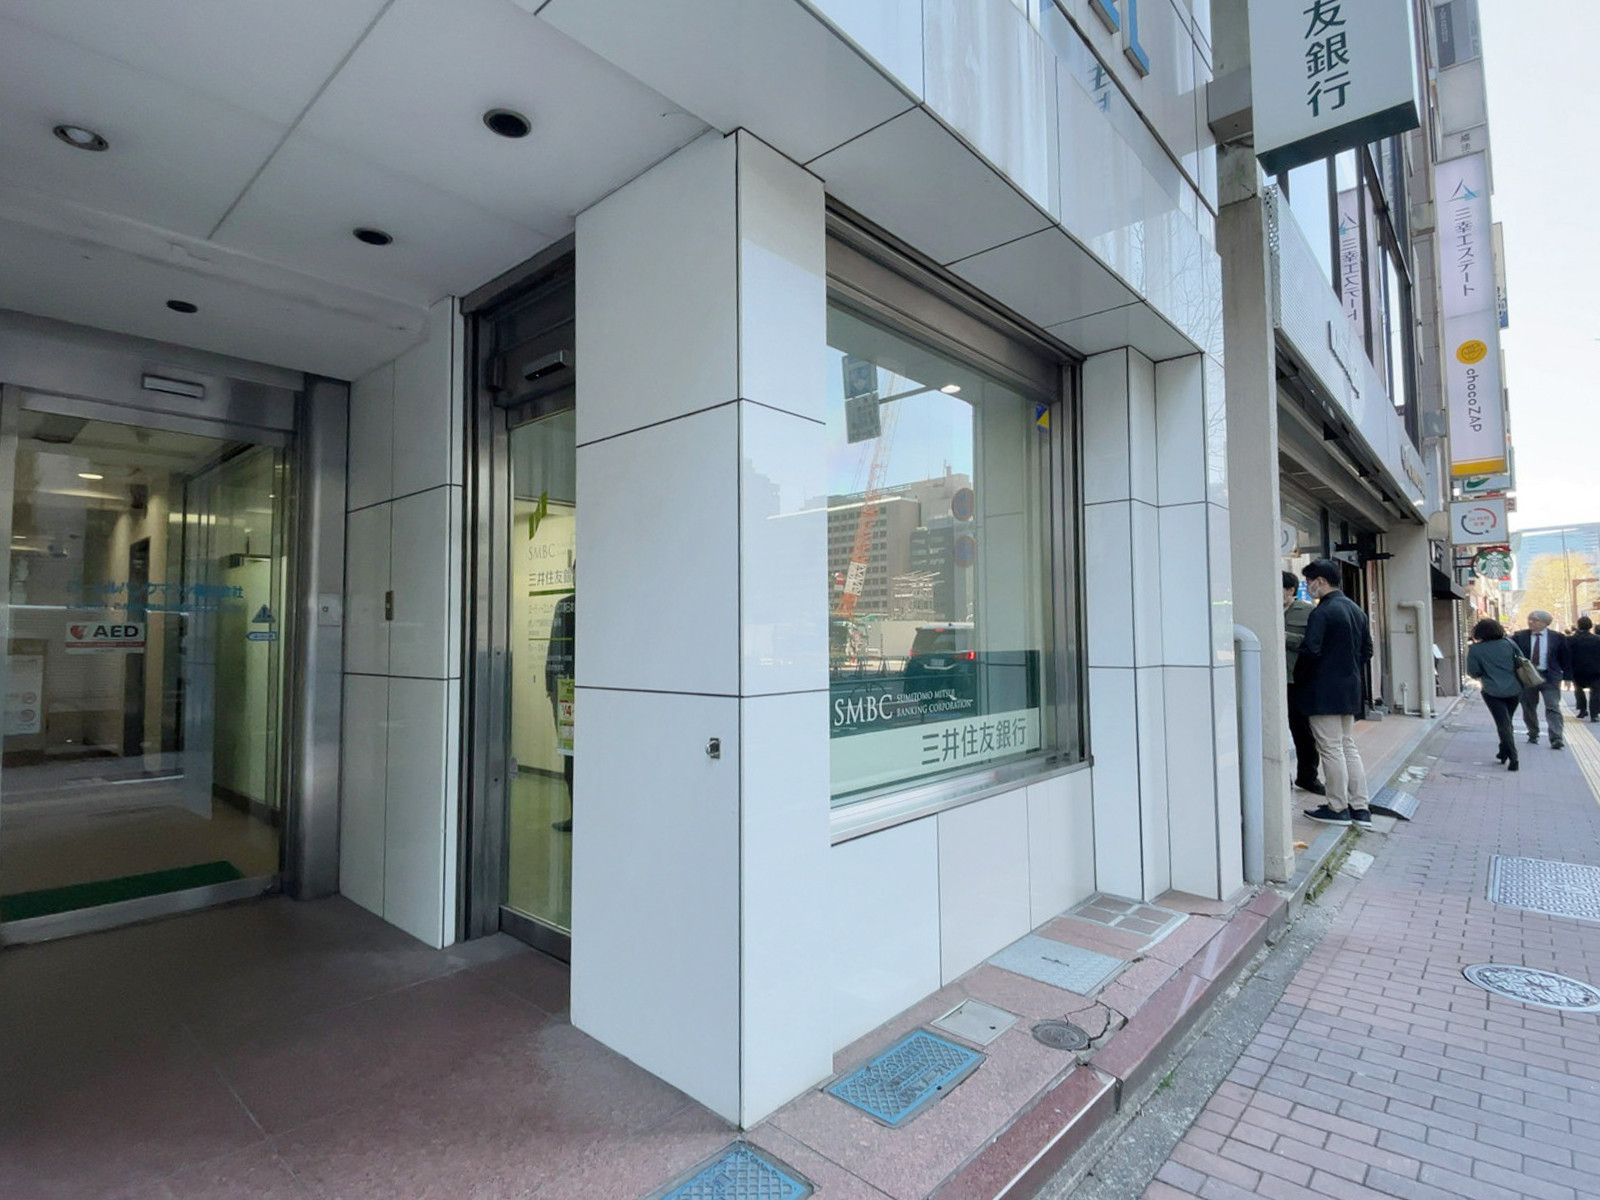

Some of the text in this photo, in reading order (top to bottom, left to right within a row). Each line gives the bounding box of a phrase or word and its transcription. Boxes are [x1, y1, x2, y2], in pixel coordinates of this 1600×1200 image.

[1302, 0, 1352, 118] 友銀行
[1454, 207, 1476, 297] 三幸エステート
[1466, 368, 1482, 432] chocoZAP
[93, 625, 139, 638] AED
[834, 694, 893, 727] SMBC
[921, 717, 1027, 766] 三井住友銀行
